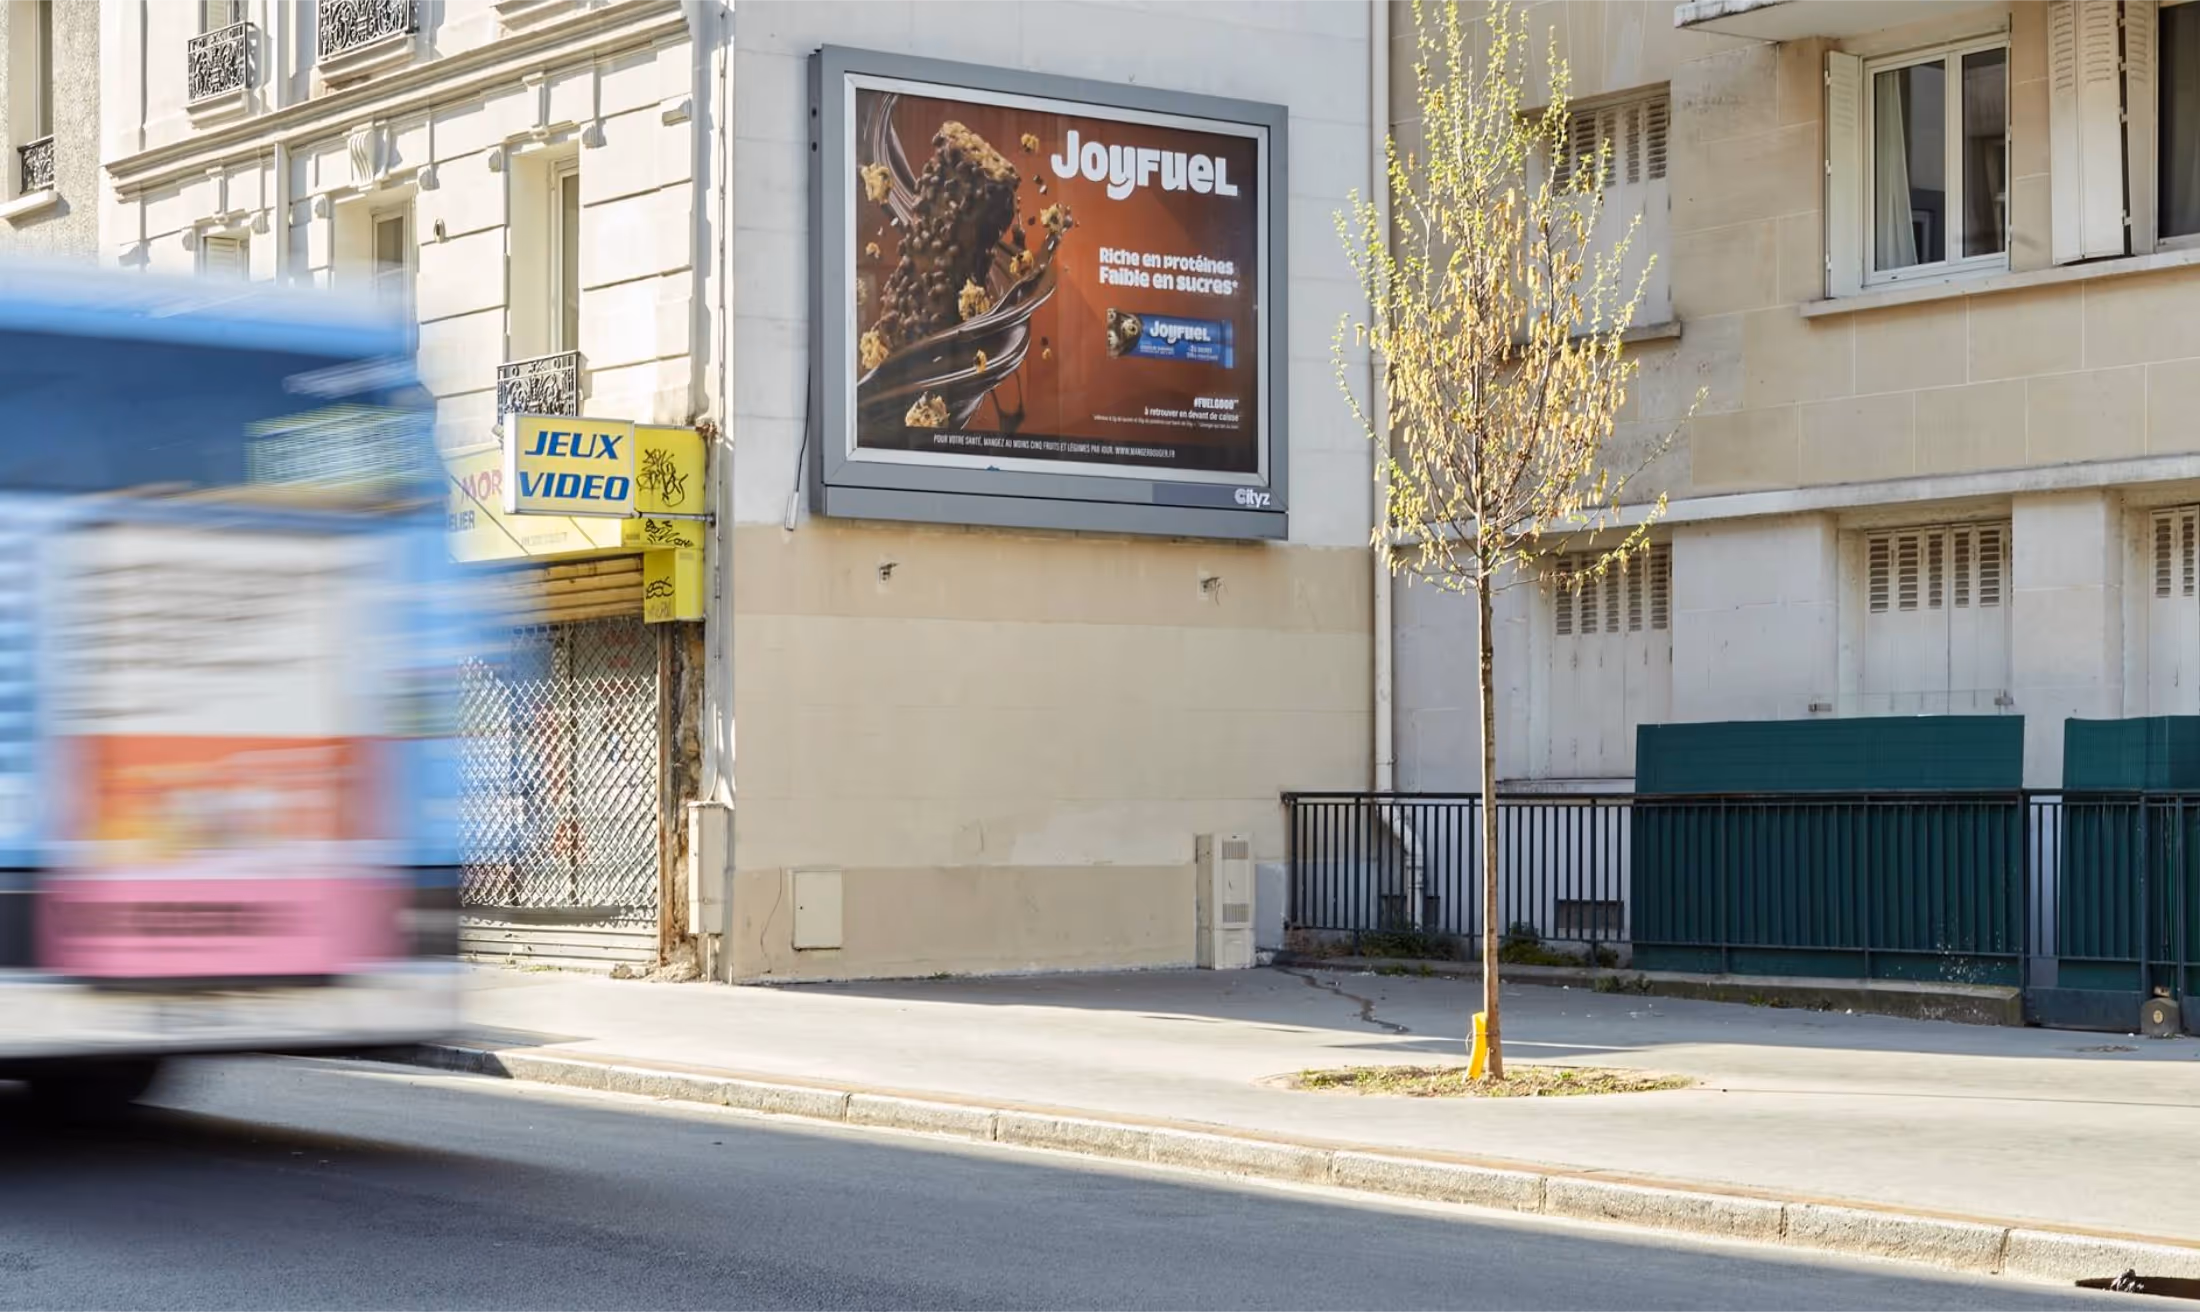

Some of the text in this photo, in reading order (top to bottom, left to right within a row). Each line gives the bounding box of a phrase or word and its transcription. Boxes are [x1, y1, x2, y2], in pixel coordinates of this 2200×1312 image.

[1099, 247, 1234, 275] Riche en protéines
[1099, 266, 1150, 288] Faible
[1152, 272, 1174, 290] en
[1149, 407, 1178, 418] retrouver
[1179, 410, 1188, 418] en
[1188, 409, 1209, 420] devant
[1209, 411, 1218, 420] de
[1218, 412, 1239, 422] caisse
[524, 430, 624, 460] JEUX
[519, 471, 630, 501] VIDEO
[1234, 488, 1270, 508] Cityz
